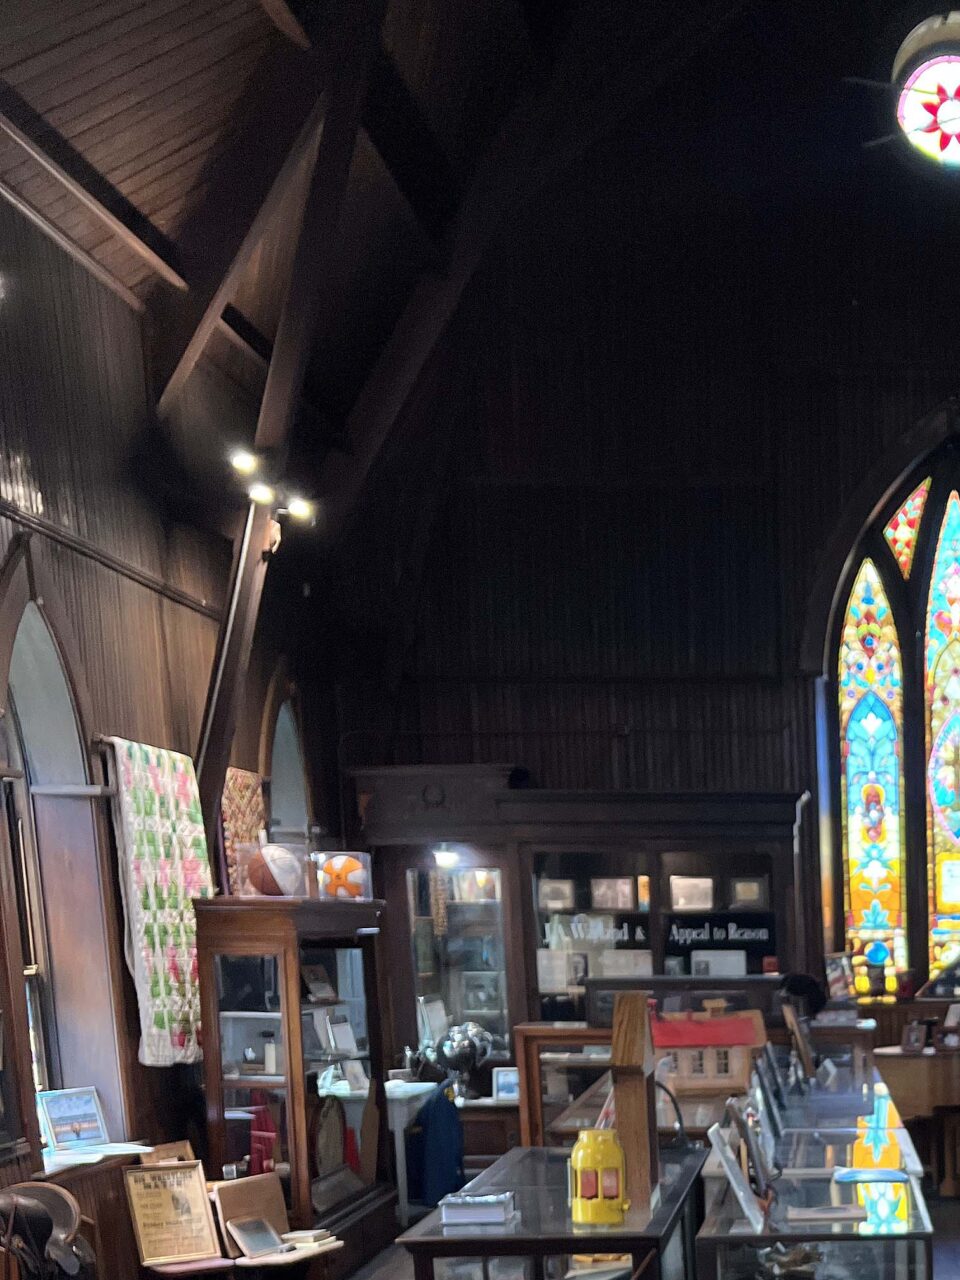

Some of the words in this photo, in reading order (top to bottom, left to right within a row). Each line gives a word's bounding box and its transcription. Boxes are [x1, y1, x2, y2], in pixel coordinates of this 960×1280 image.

[669, 922, 710, 945] Appeal
[713, 927, 726, 940] to
[727, 922, 769, 940] Reason
